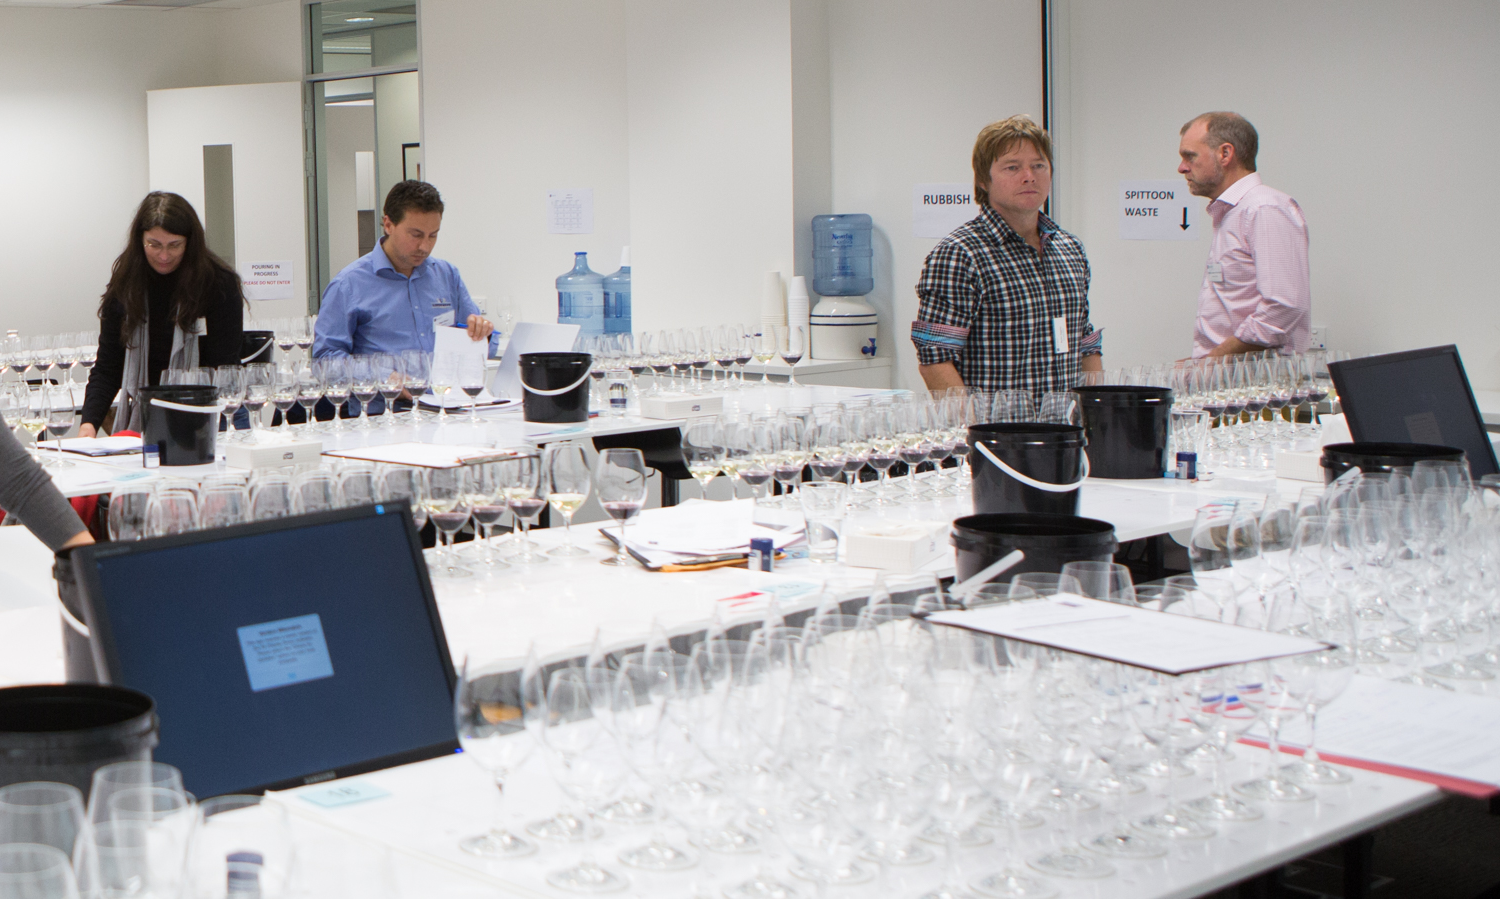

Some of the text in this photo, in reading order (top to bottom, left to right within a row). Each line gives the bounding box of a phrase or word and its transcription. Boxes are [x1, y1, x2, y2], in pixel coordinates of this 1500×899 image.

[923, 194, 971, 205] RUBBISH
[1125, 190, 1174, 200] SPITTOON
[1124, 207, 1159, 217] WASTE
